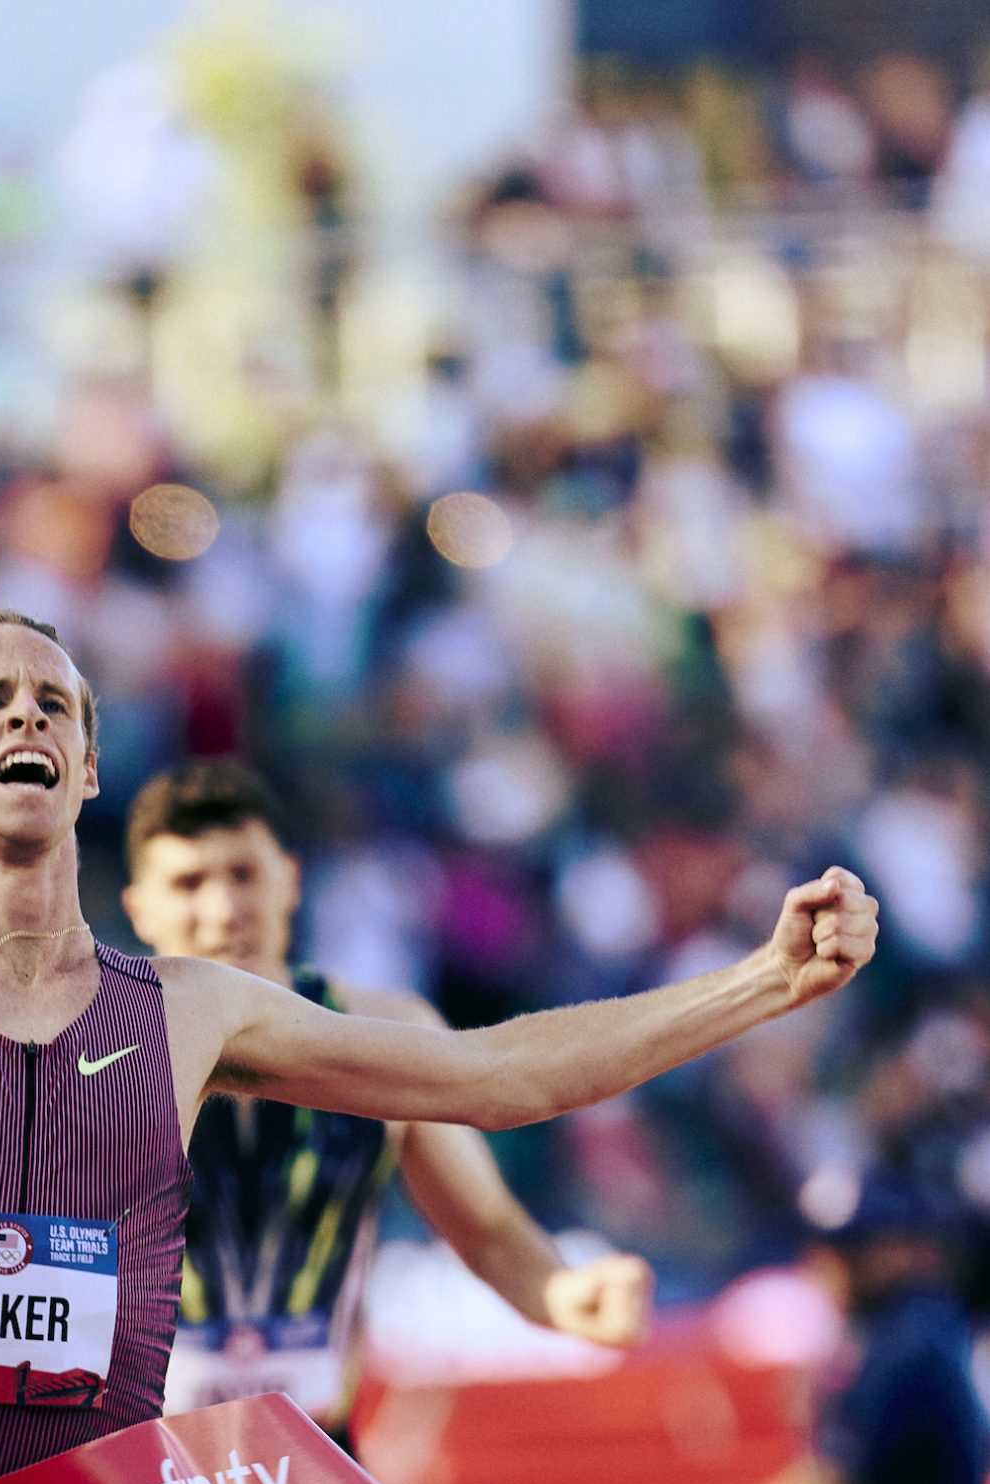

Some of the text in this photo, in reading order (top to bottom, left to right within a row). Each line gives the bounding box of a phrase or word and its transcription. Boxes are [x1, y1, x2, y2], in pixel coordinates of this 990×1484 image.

[50, 1224, 108, 1242] U.S. OLYMPIC
[49, 1237, 109, 1255] TEAM TRIALS
